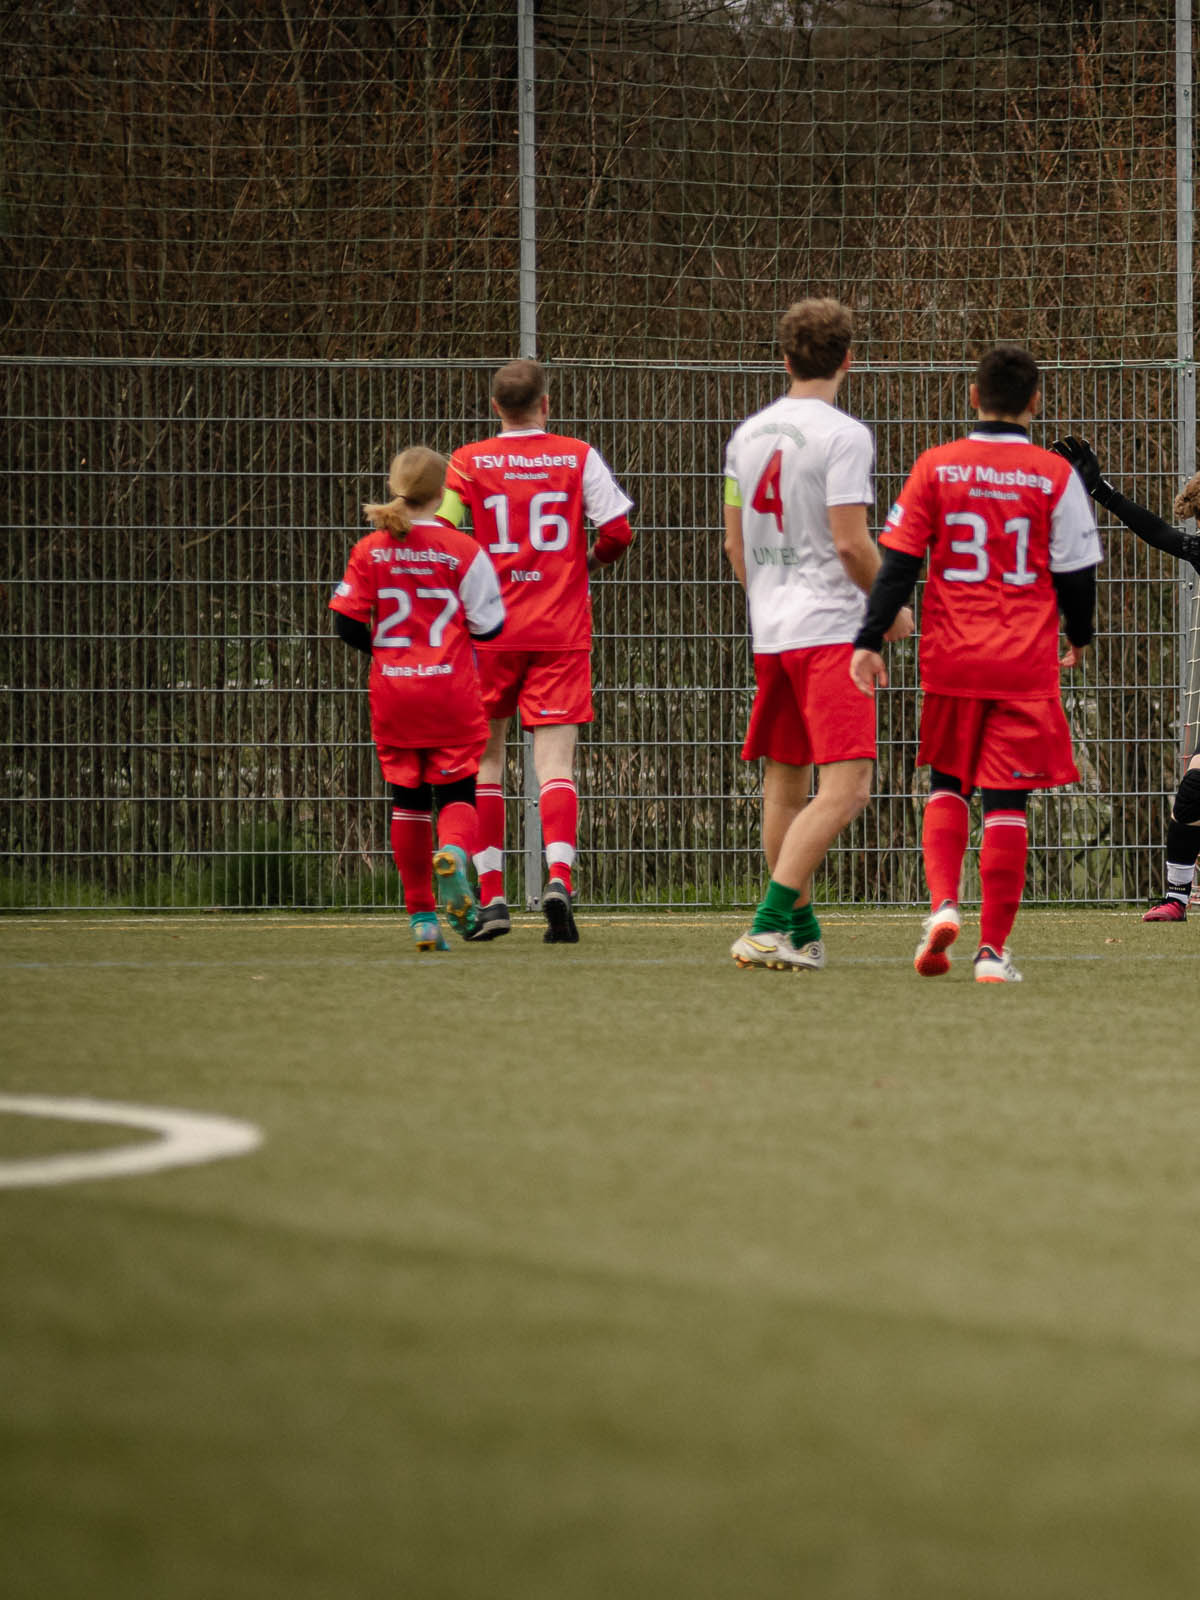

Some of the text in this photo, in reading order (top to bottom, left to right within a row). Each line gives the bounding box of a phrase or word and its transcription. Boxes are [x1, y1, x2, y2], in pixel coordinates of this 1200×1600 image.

[472, 453, 577, 469] TSV Musberg
[752, 449, 784, 534] 4
[936, 465, 1052, 495] TSV Musberg
[483, 491, 569, 554] 16
[943, 511, 1037, 586] 31
[395, 548, 459, 570] Musberg
[373, 587, 459, 648] 27
